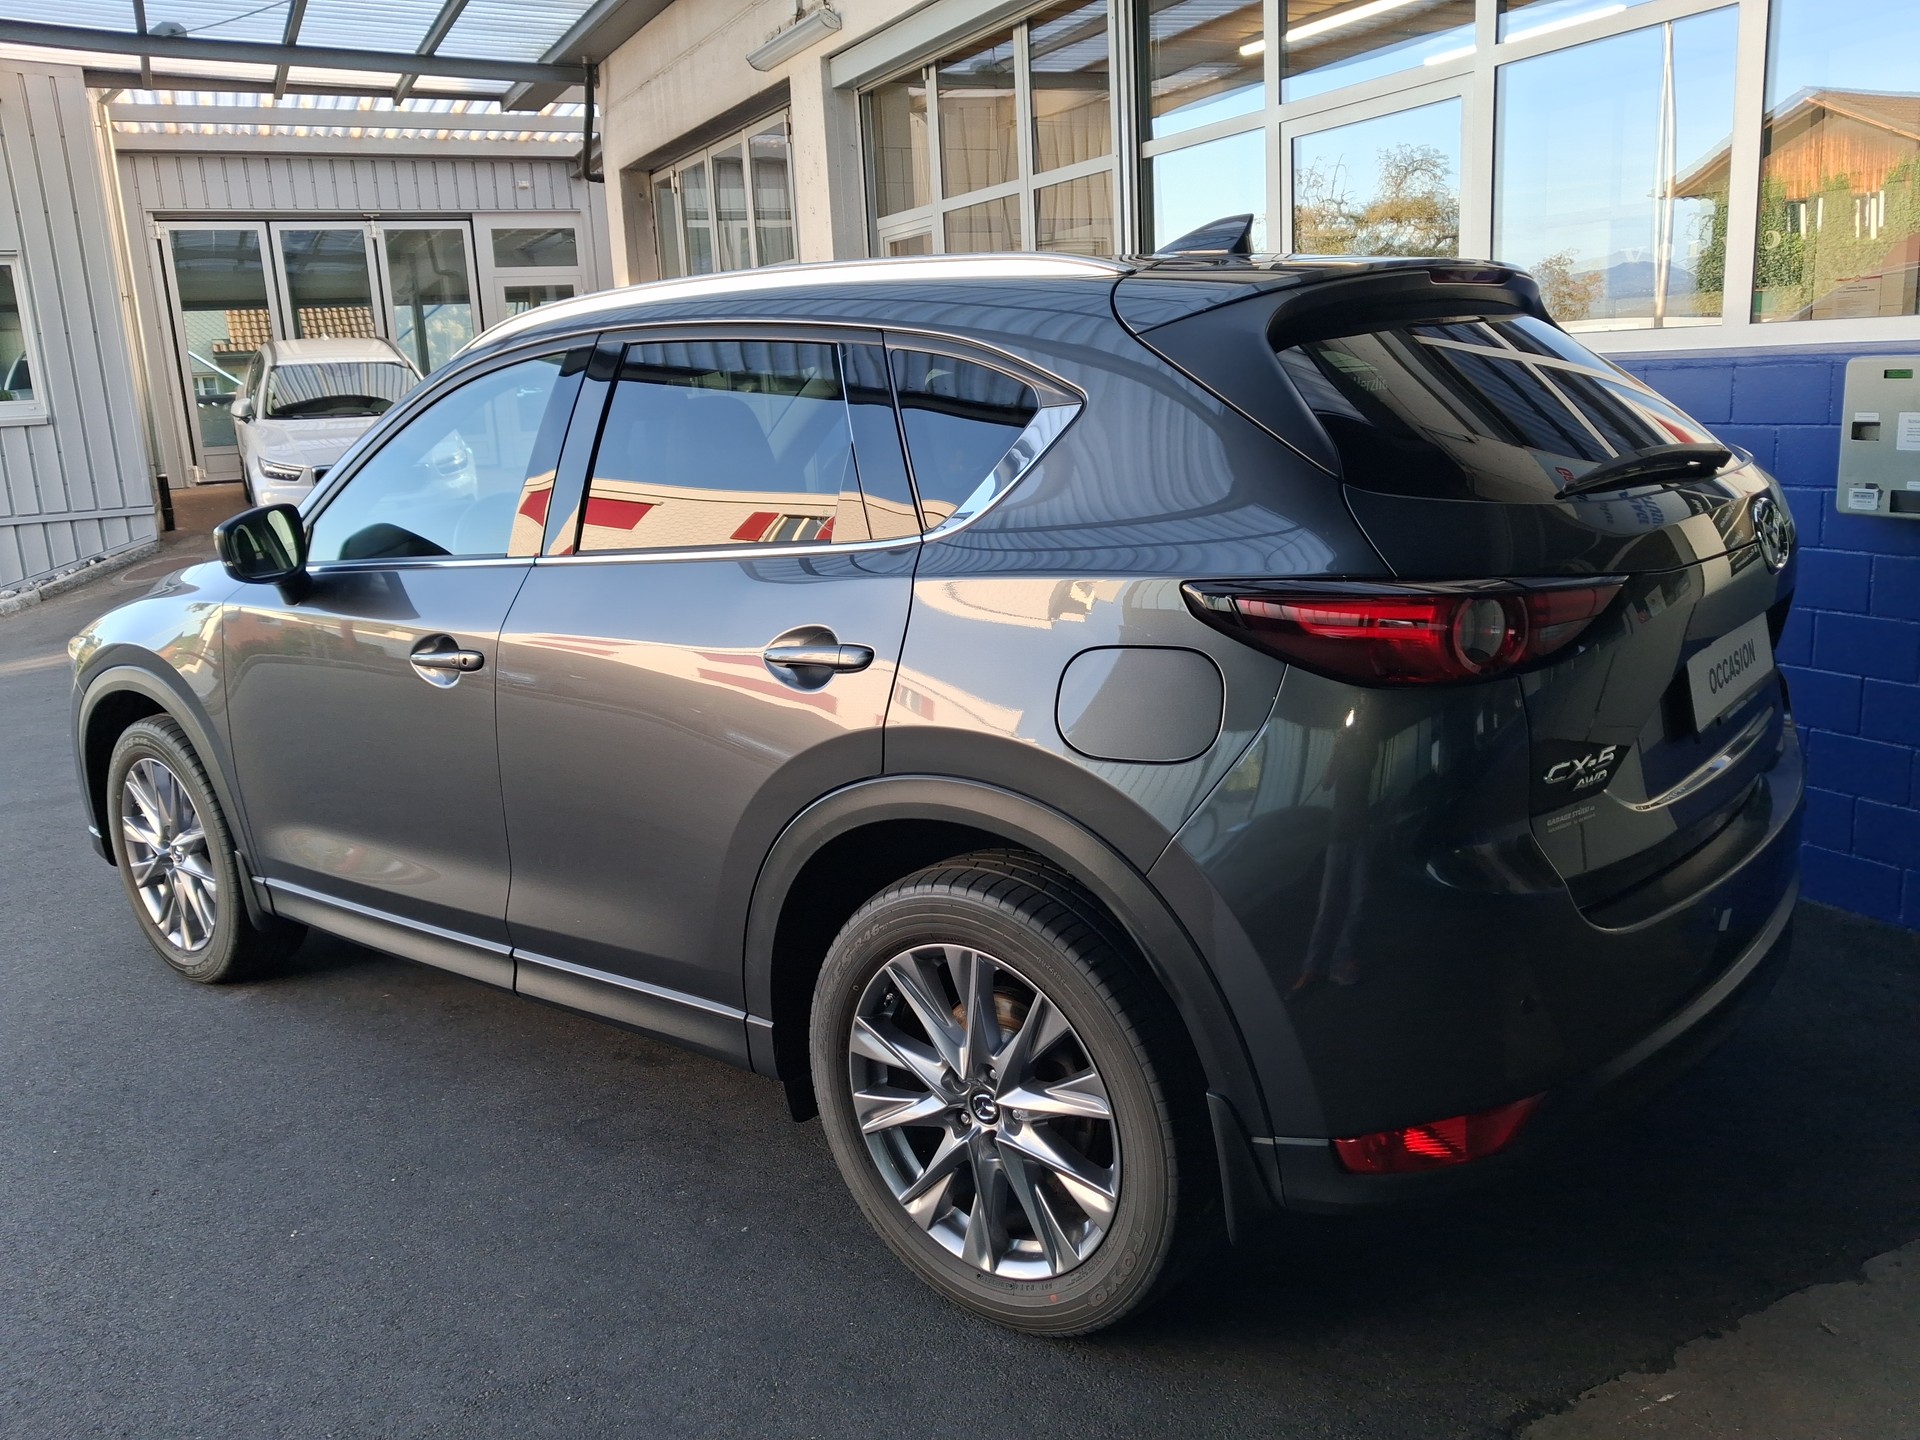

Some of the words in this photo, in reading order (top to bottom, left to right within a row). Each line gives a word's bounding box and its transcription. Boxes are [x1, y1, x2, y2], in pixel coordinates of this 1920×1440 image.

[1620, 229, 1782, 263] VOLO
[1708, 638, 1756, 694] OCCASION
[1543, 744, 1617, 784] CX-5
[1572, 769, 1608, 792] AWD
[1547, 813, 1572, 827] GARAGE
[1087, 1229, 1148, 1307] TOYO
